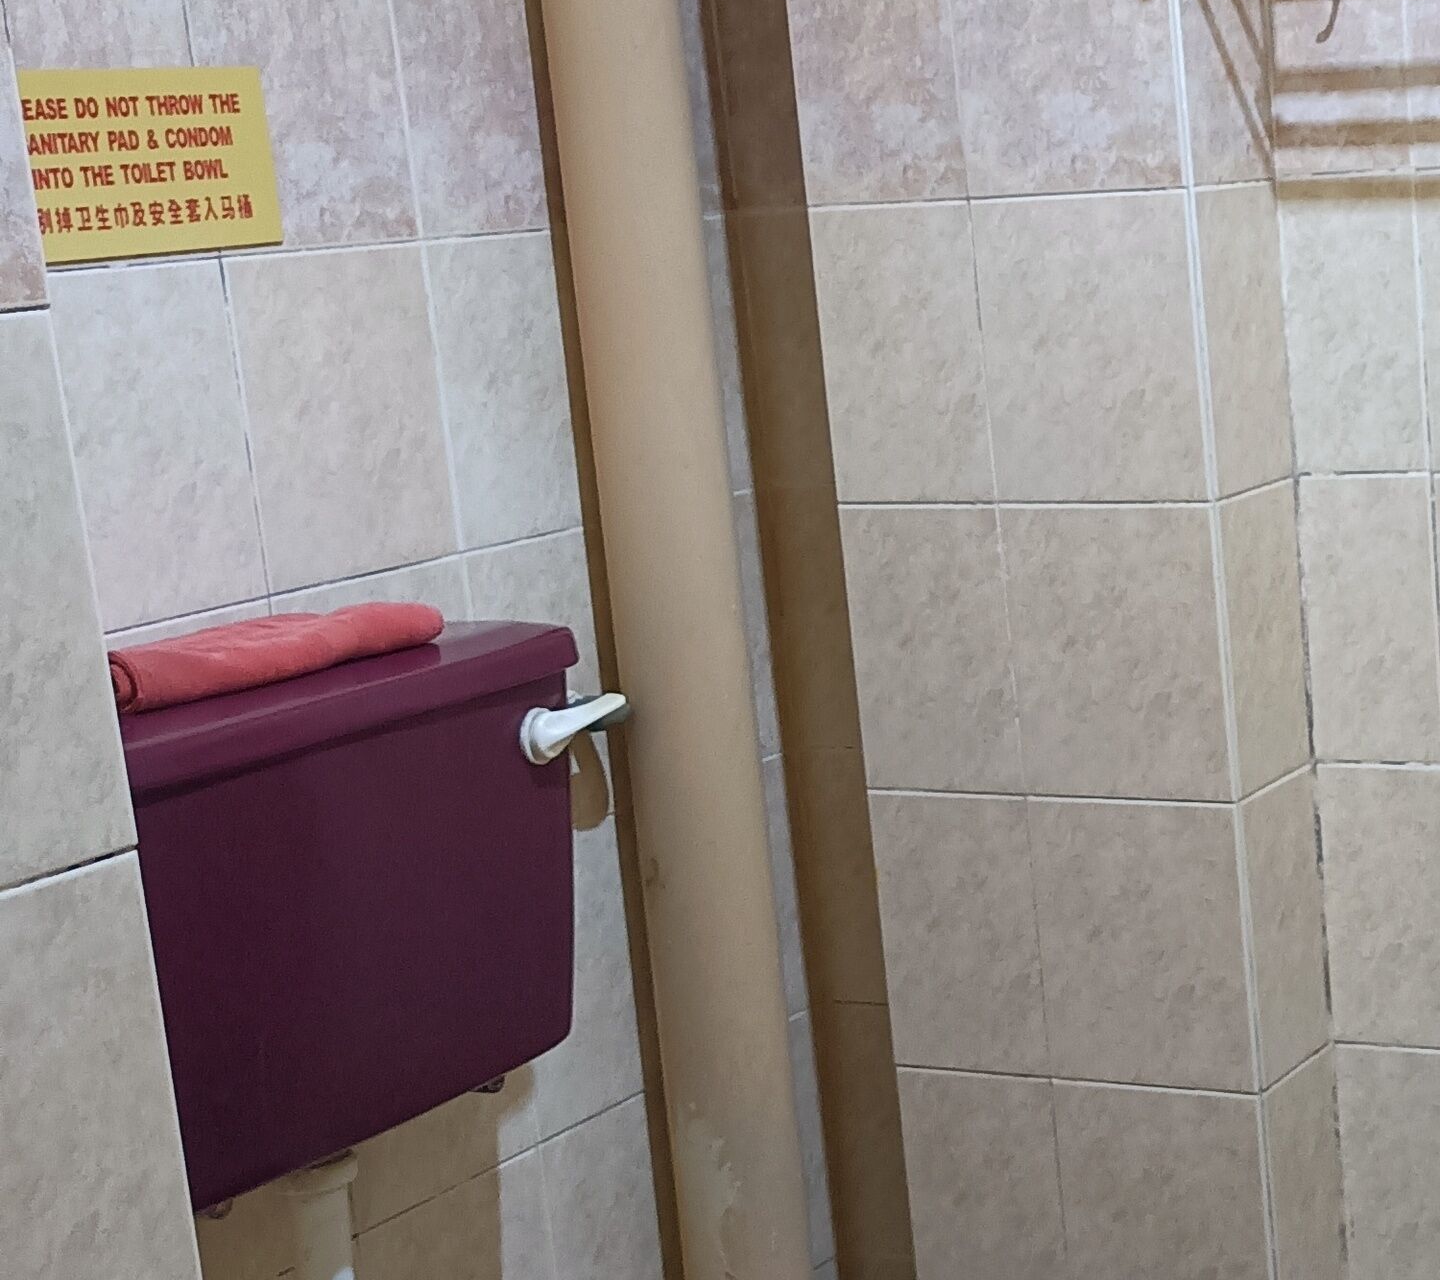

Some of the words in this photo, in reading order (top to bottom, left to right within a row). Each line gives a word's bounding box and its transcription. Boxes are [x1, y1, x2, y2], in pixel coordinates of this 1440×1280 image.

[21, 98, 69, 121] EASE
[74, 96, 100, 119] DO
[105, 96, 139, 117] NOT
[145, 94, 203, 116] THROW
[208, 93, 241, 114] THE
[27, 130, 100, 156] ANITARY
[106, 130, 139, 152] PAD
[146, 128, 159, 150] &
[164, 126, 233, 149] CONDOM
[31, 167, 74, 190] INTO
[79, 164, 115, 187] THE
[120, 161, 176, 184] TOILET
[182, 158, 229, 181] BOWL
